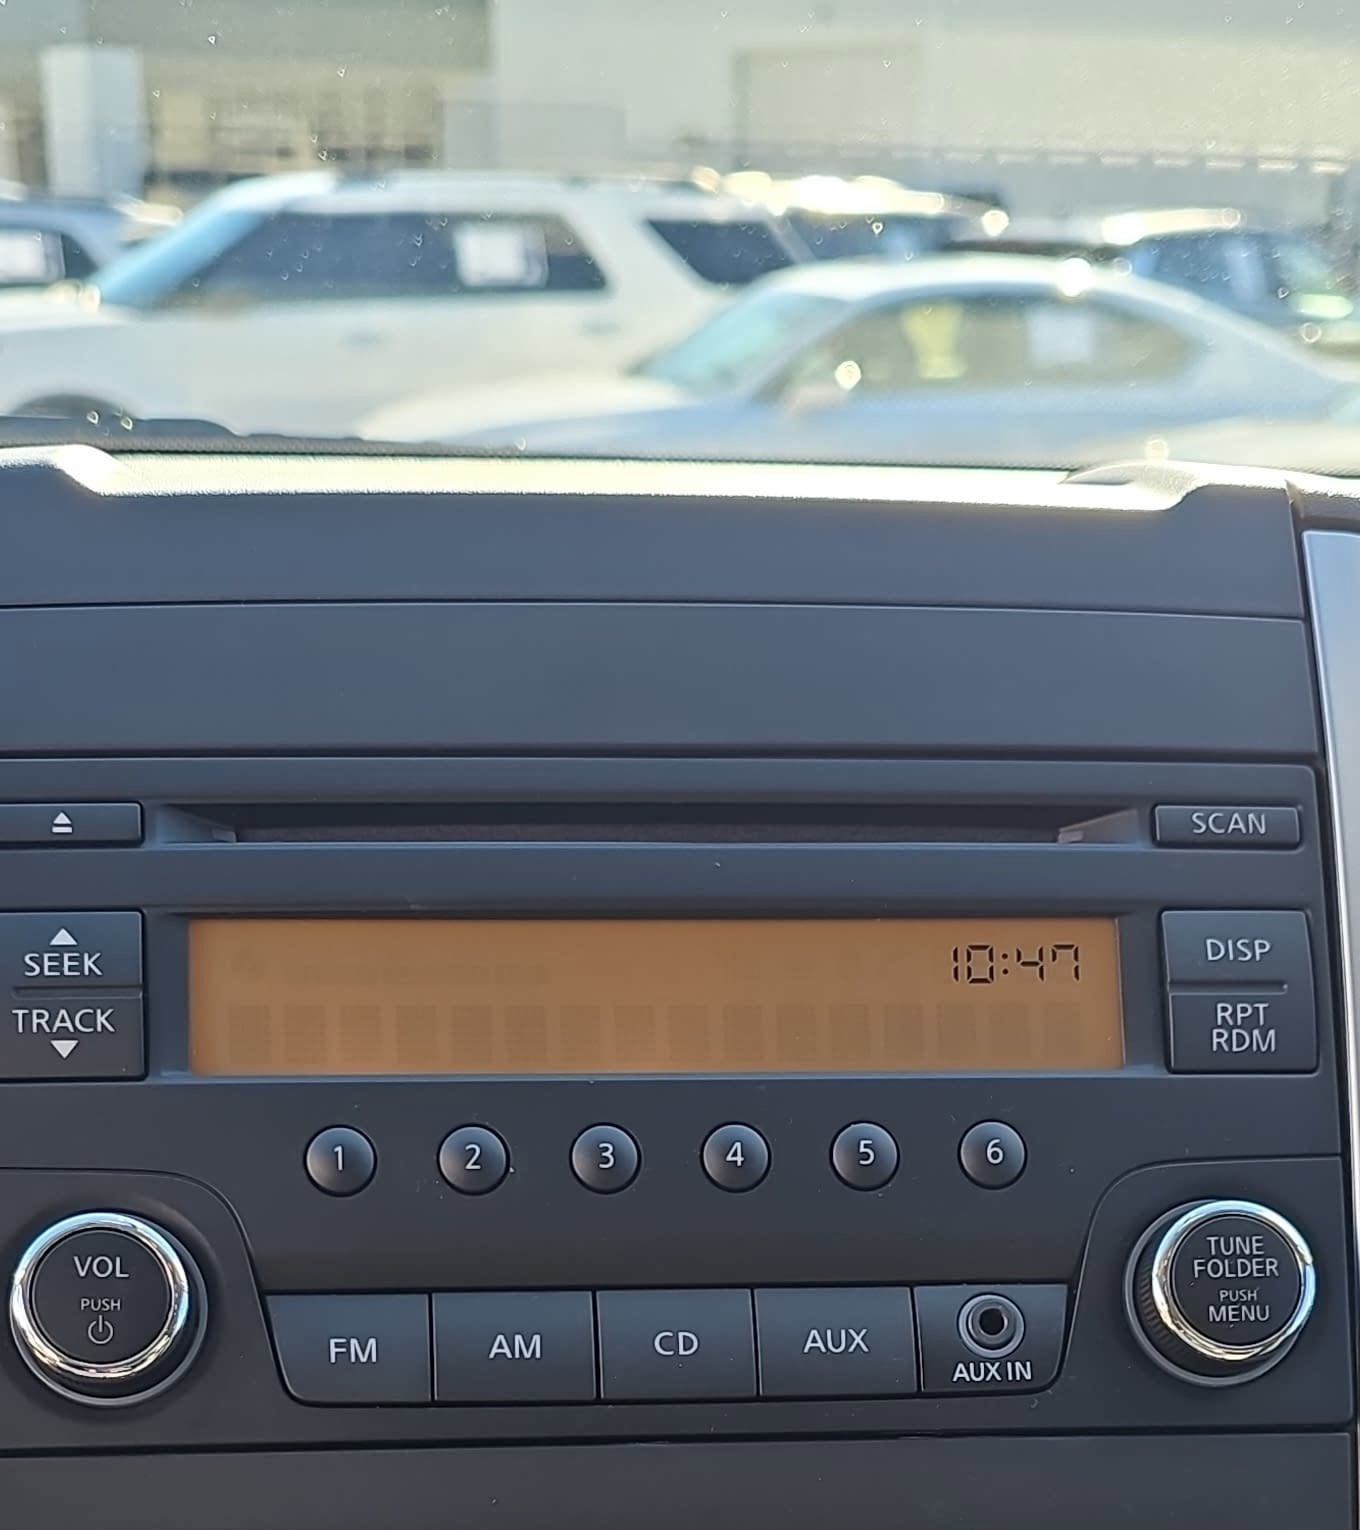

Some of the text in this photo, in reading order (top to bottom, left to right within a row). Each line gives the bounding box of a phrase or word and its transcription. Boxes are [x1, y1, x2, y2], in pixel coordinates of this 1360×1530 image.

[1192, 813, 1267, 833] SCAN
[1207, 939, 1270, 960] DISP
[25, 953, 101, 976] SEEK
[952, 944, 1081, 985] 10:47
[12, 1009, 114, 1032] TRACK
[1214, 1003, 1268, 1026] RPT
[1213, 1029, 1275, 1051] RDM
[332, 1146, 344, 1170] 1
[466, 1145, 480, 1169] 2
[600, 1143, 613, 1168] 3
[726, 1142, 744, 1165] 4
[860, 1140, 874, 1164] 5
[987, 1140, 1003, 1163] 6
[1207, 1236, 1264, 1256] TUNE
[74, 1257, 128, 1277] VOL
[1194, 1258, 1278, 1277] FOLDER
[81, 1299, 120, 1310] PUSH
[1220, 1290, 1256, 1301] PUSH
[1209, 1305, 1269, 1321] MENU
[330, 1338, 376, 1362] FM
[490, 1335, 540, 1358] AM
[655, 1332, 697, 1354] CD
[804, 1329, 868, 1352] AUX
[953, 1362, 1031, 1381] AUX IN
